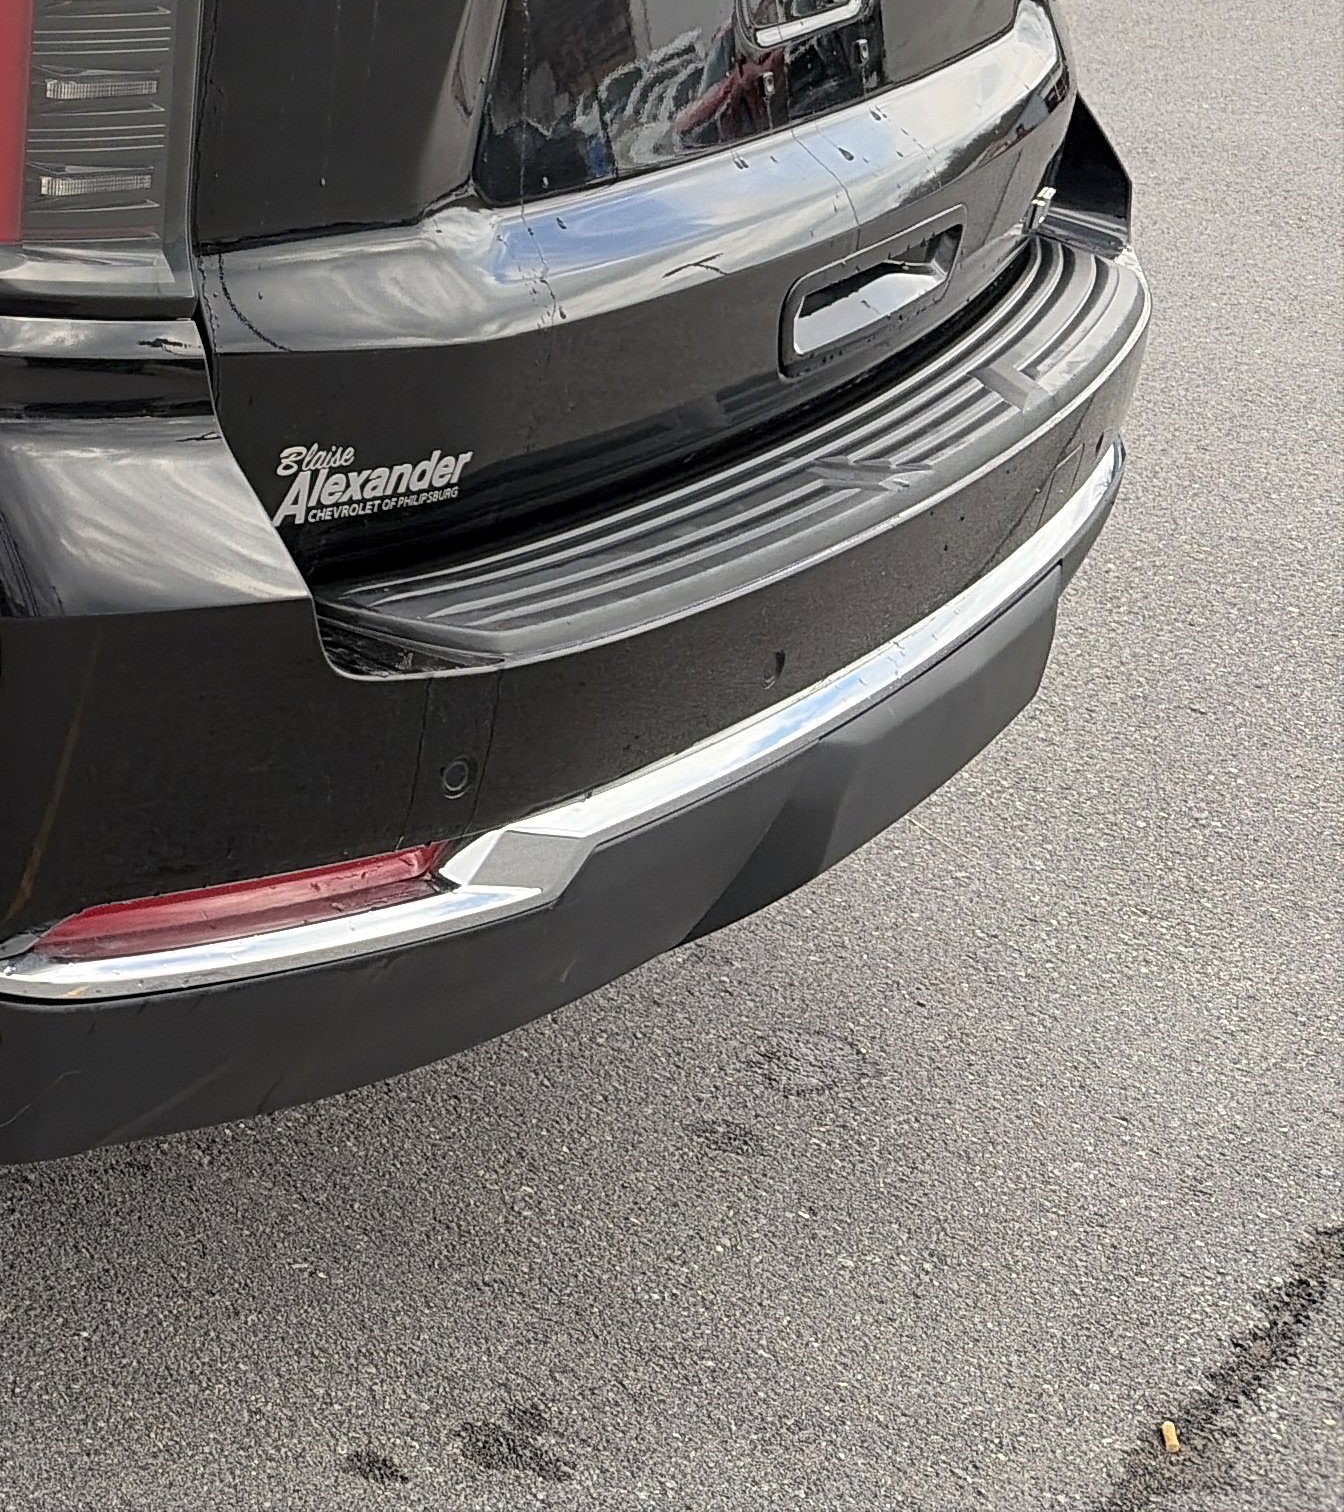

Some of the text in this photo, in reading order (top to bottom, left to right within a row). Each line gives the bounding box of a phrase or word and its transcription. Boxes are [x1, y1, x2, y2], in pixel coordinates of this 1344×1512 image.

[276, 442, 355, 477] Blaise
[271, 449, 474, 527] Alexander
[307, 486, 459, 524] CHEVROLET OF PHILIPSBURG
